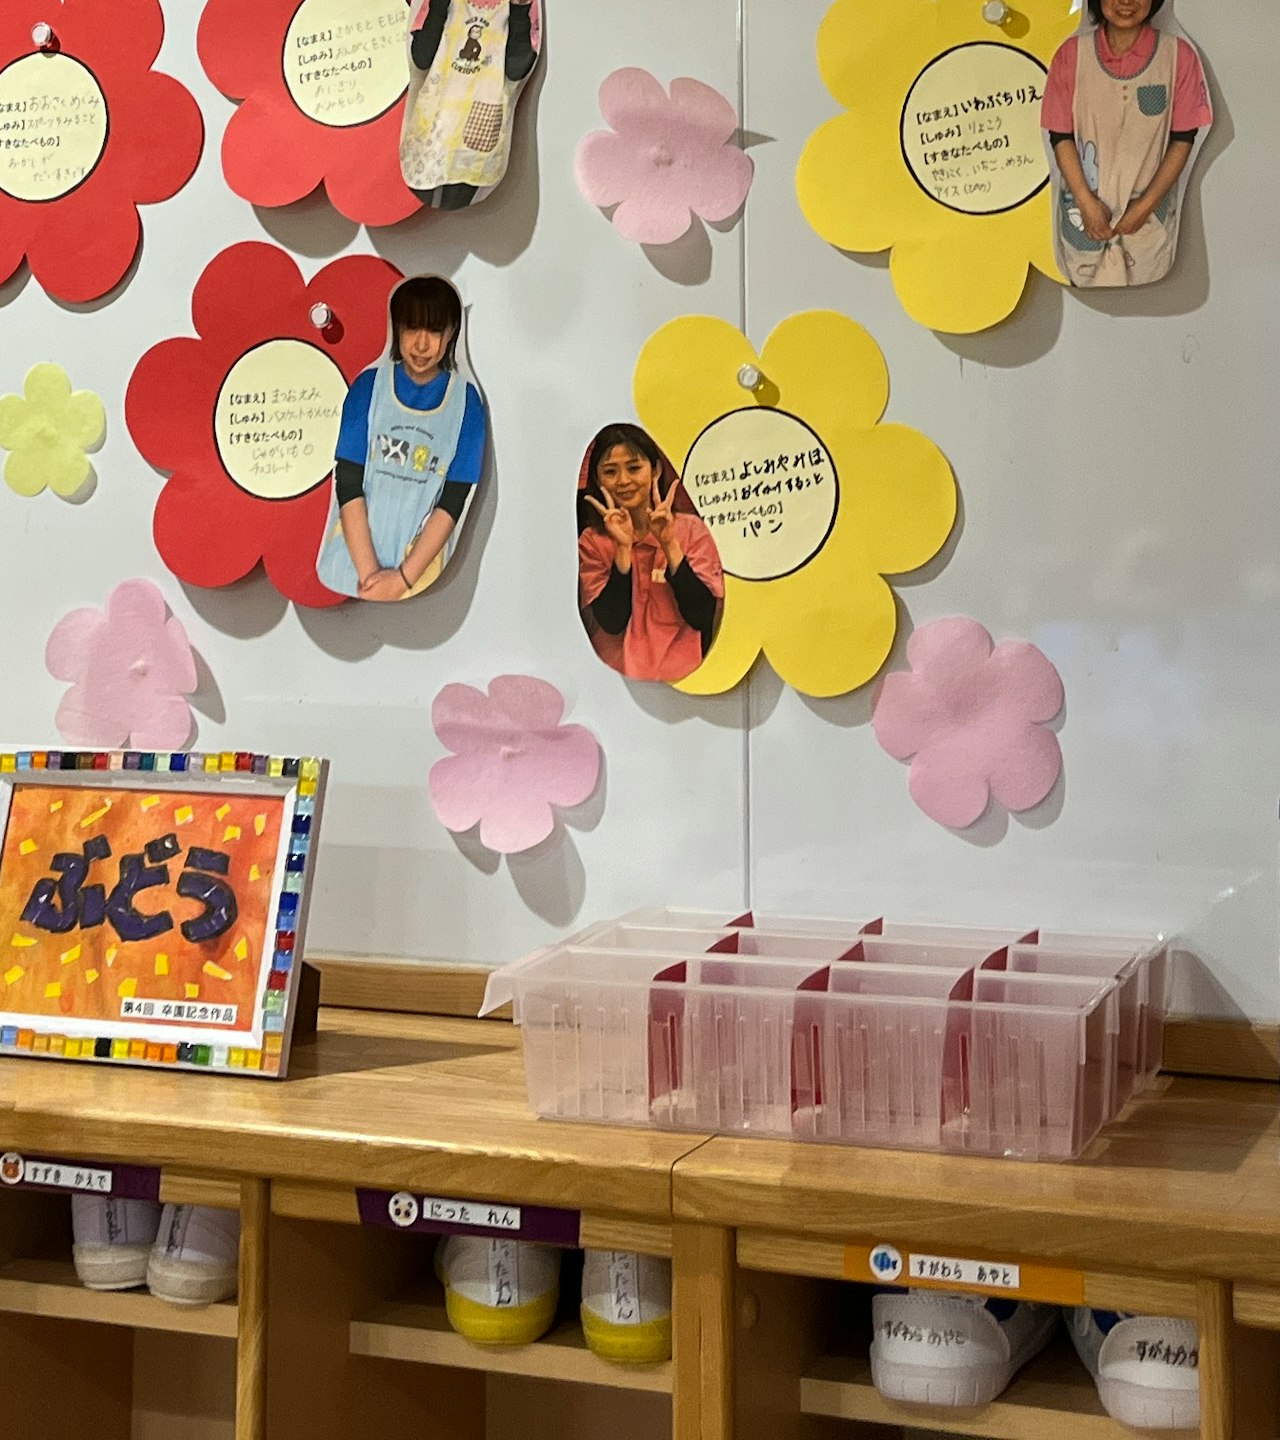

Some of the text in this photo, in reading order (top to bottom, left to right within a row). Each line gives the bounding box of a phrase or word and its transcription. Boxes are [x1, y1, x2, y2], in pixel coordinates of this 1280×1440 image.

[968, 115, 1004, 135] りょこう
[743, 519, 784, 539] パン
[19, 832, 240, 944] ぶどう
[123, 1001, 237, 1023] 第4回 卒園記念作品
[32, 1165, 107, 1190] すずき かえで
[430, 1201, 514, 1227] にった れん
[916, 1258, 1012, 1287] すがわら あやと
